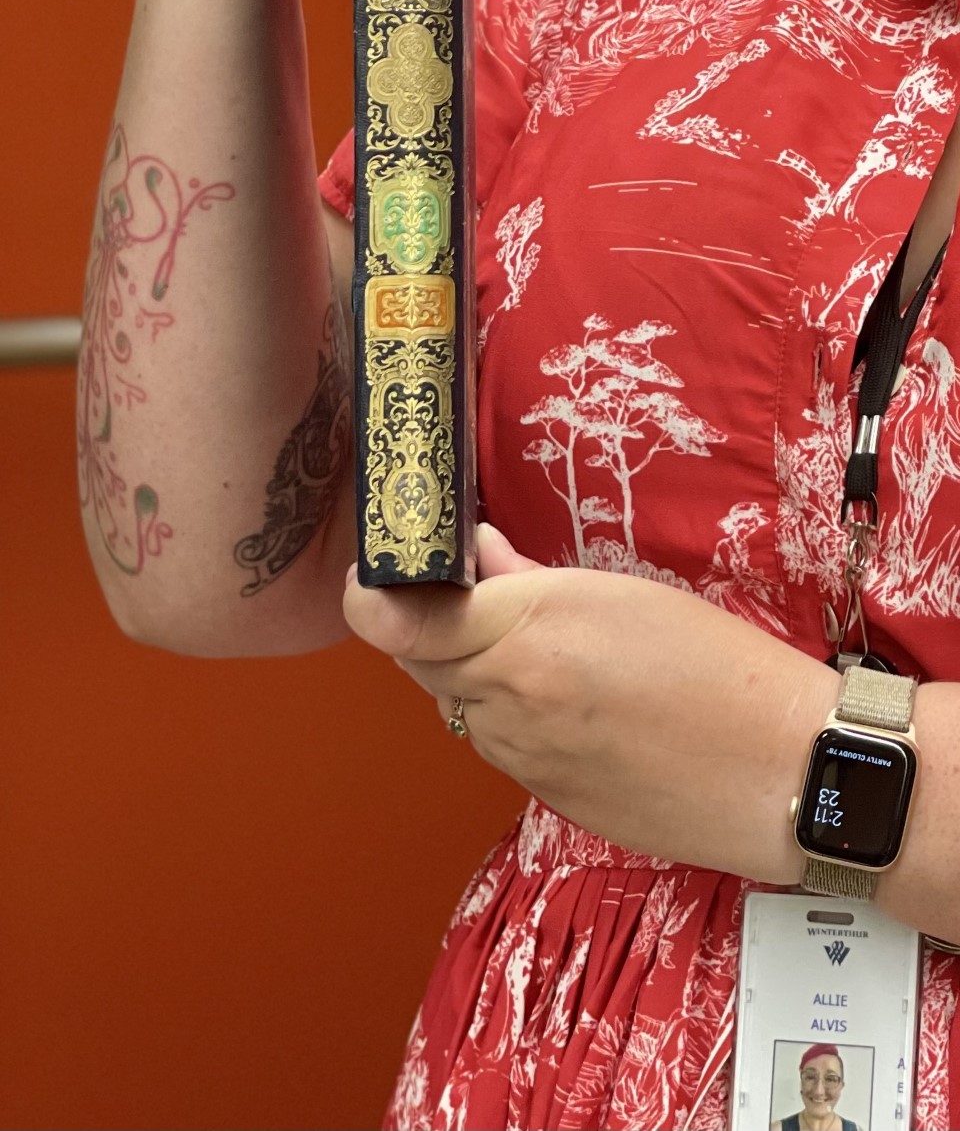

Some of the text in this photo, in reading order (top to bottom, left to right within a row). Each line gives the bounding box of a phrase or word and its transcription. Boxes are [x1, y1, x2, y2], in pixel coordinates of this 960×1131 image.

[838, 750, 866, 760] CLOUDY
[867, 756, 892, 767] PARTLY
[818, 788, 841, 806] 23
[814, 806, 844, 827] 2:11
[807, 927, 869, 939] WINTERTHUR
[812, 992, 848, 1007] ALLIE
[810, 1018, 848, 1033] ALVIS
